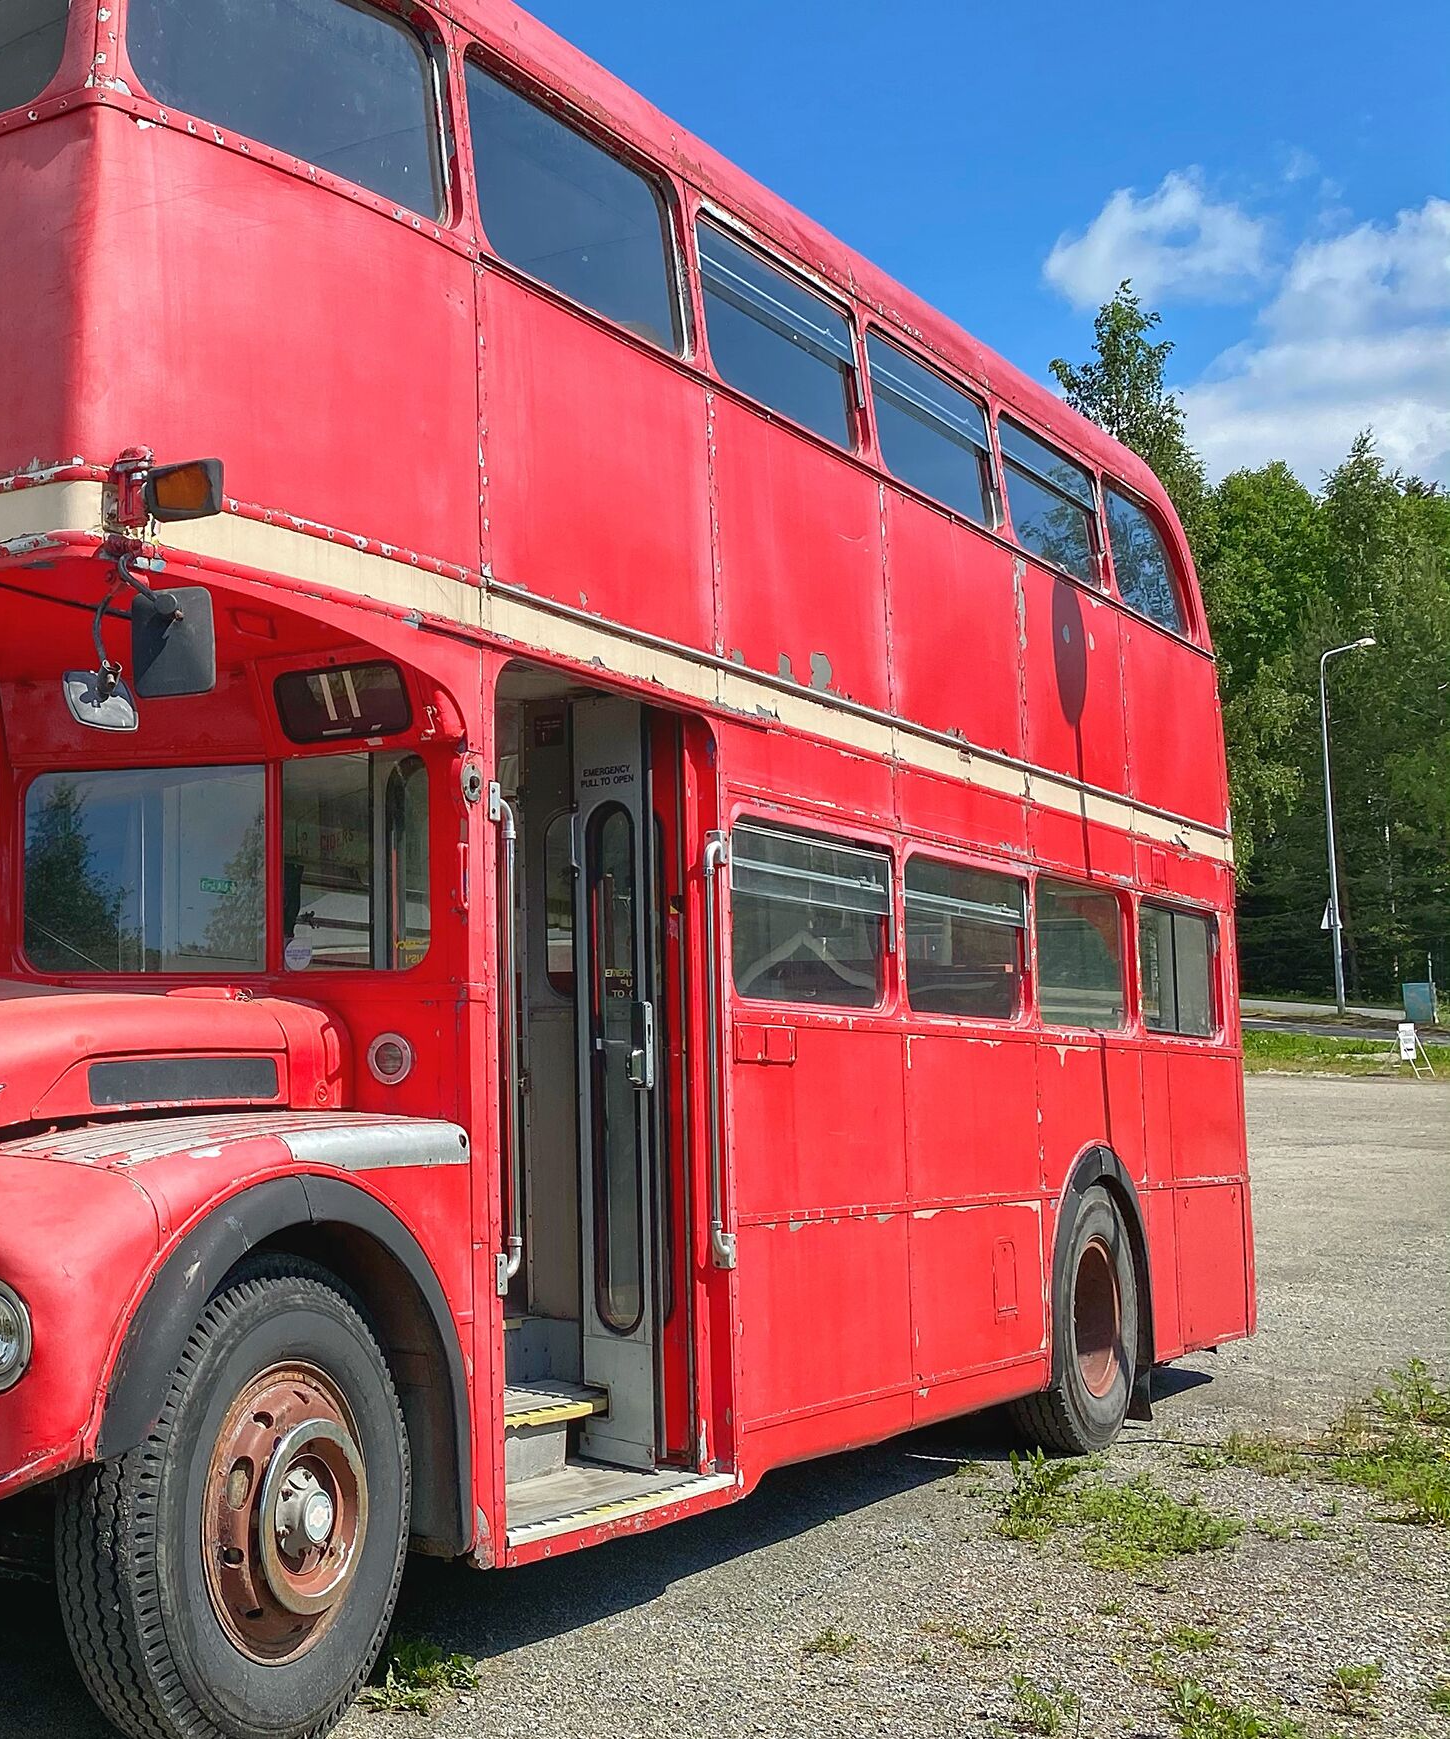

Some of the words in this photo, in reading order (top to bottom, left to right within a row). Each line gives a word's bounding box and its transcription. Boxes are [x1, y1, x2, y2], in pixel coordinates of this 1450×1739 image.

[319, 670, 361, 721] 11
[583, 764, 630, 777] EMERGENCY
[581, 780, 599, 788] PULL
[600, 777, 610, 786] TO
[613, 774, 634, 784] OPEN
